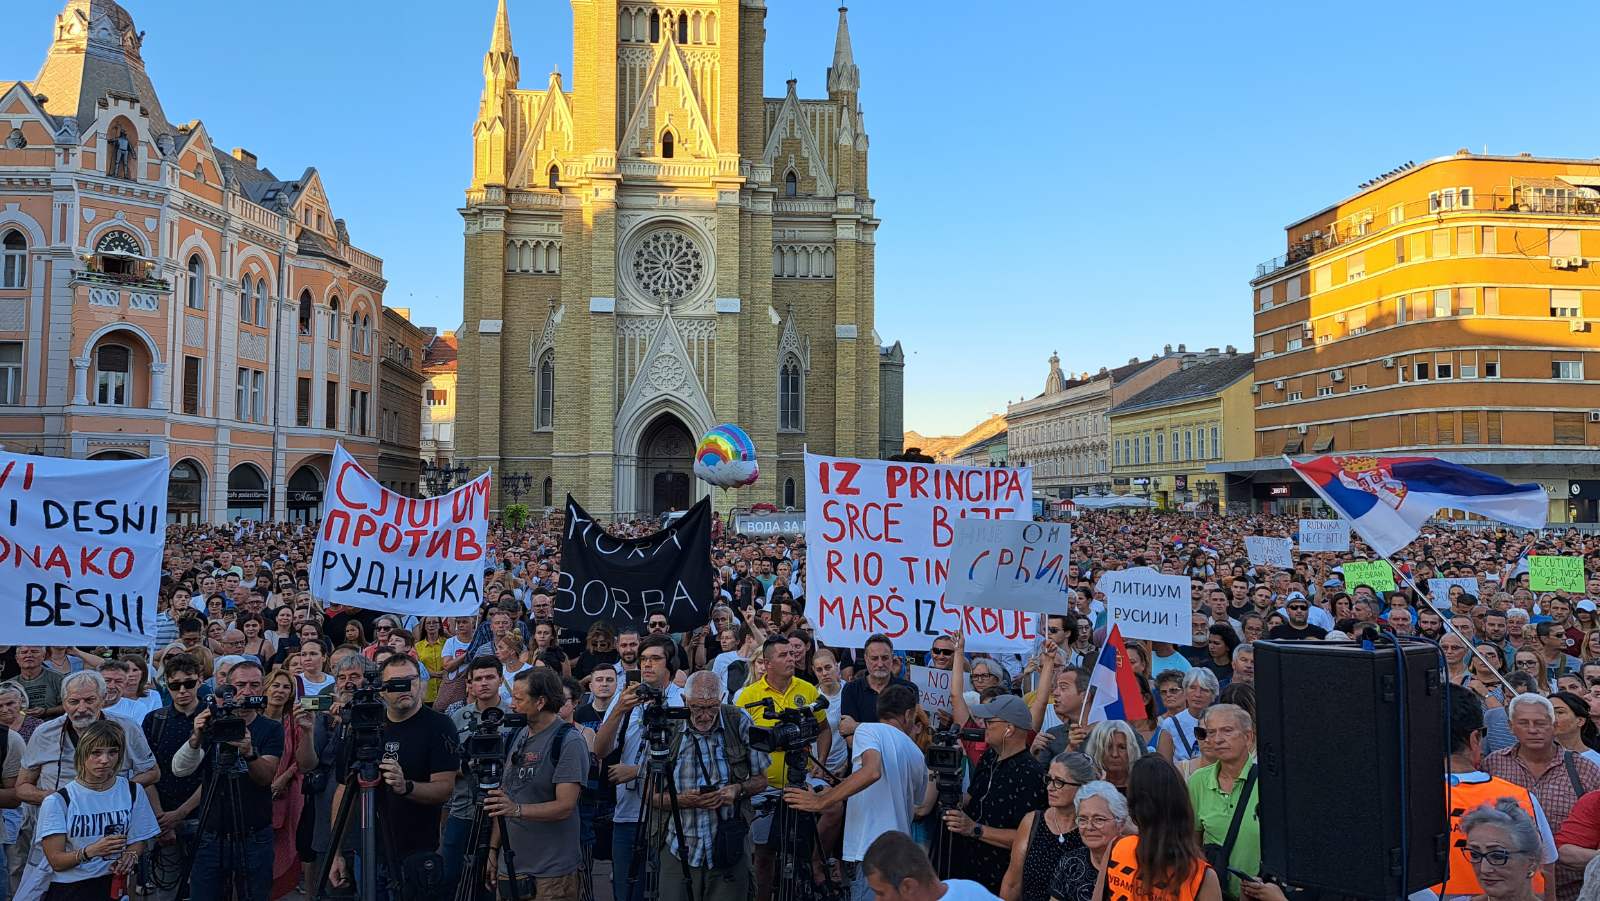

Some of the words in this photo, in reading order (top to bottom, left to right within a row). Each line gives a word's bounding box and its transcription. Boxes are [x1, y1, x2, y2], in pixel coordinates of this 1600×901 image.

[819, 462, 861, 495] IZ
[887, 465, 1024, 502] PRINCIPA
[43, 499, 157, 534] DESNI
[324, 509, 483, 561] ПРОТИВ
[747, 521, 780, 533] ВОДА
[783, 521, 799, 532] ЗА
[822, 500, 903, 543] SRCE
[321, 550, 480, 603] РУДНИКА
[826, 550, 883, 586] RIO
[899, 557, 950, 585] TIN
[25, 583, 144, 634] BESNI
[554, 571, 698, 623] BORBA
[1112, 581, 1181, 599] ЛИТИЈУМ
[819, 587, 908, 638] MARŠ
[915, 599, 940, 636] IZ
[1114, 607, 1168, 626] РУСИЈИ
[928, 670, 949, 690] NO
